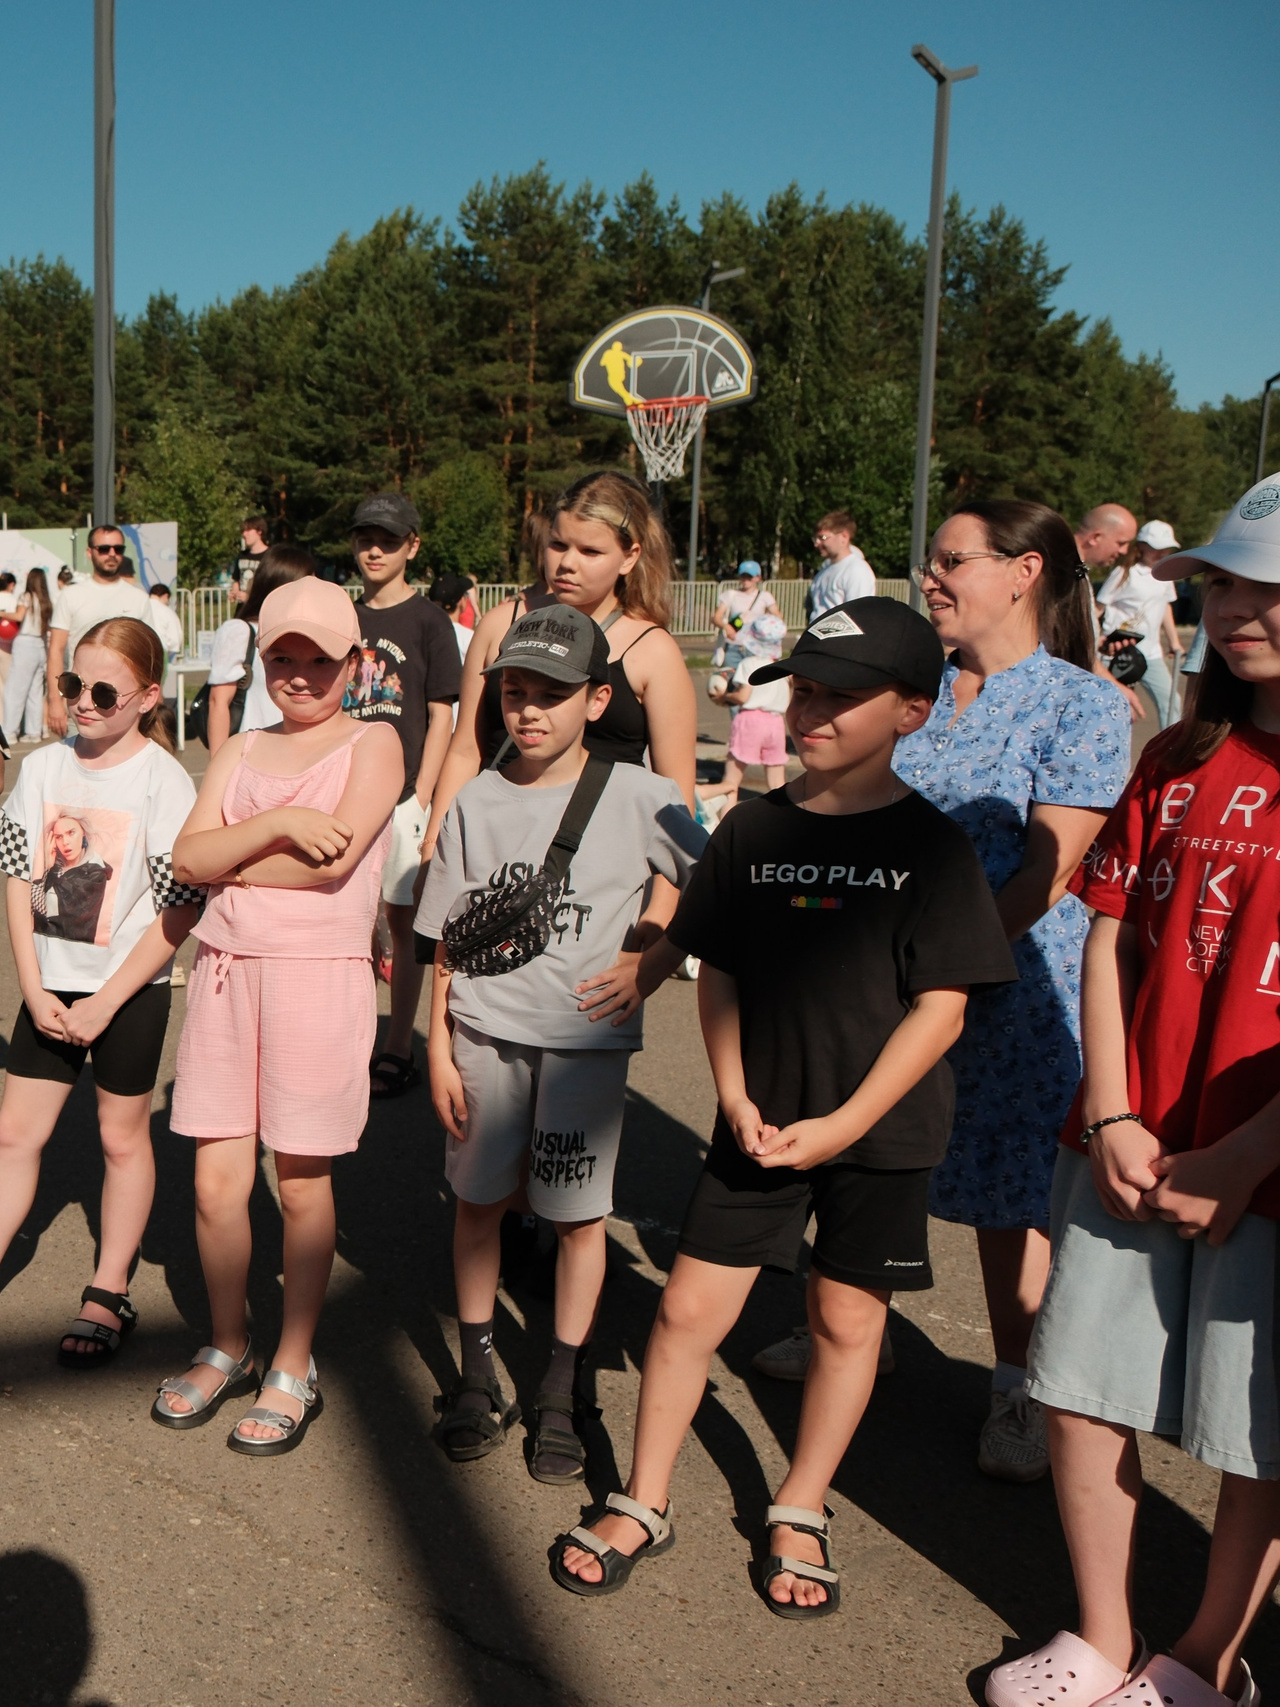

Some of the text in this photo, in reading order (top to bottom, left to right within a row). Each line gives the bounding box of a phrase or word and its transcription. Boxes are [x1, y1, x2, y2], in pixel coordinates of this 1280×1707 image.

[544, 618, 580, 642] YORK
[361, 703, 403, 717] ANYTHING
[750, 863, 911, 891] LEGO PLAY
[1191, 925, 1232, 942] NEW
[1185, 938, 1233, 960] YORK
[1186, 956, 1228, 976] CITY
[534, 1127, 587, 1160] USUAL
